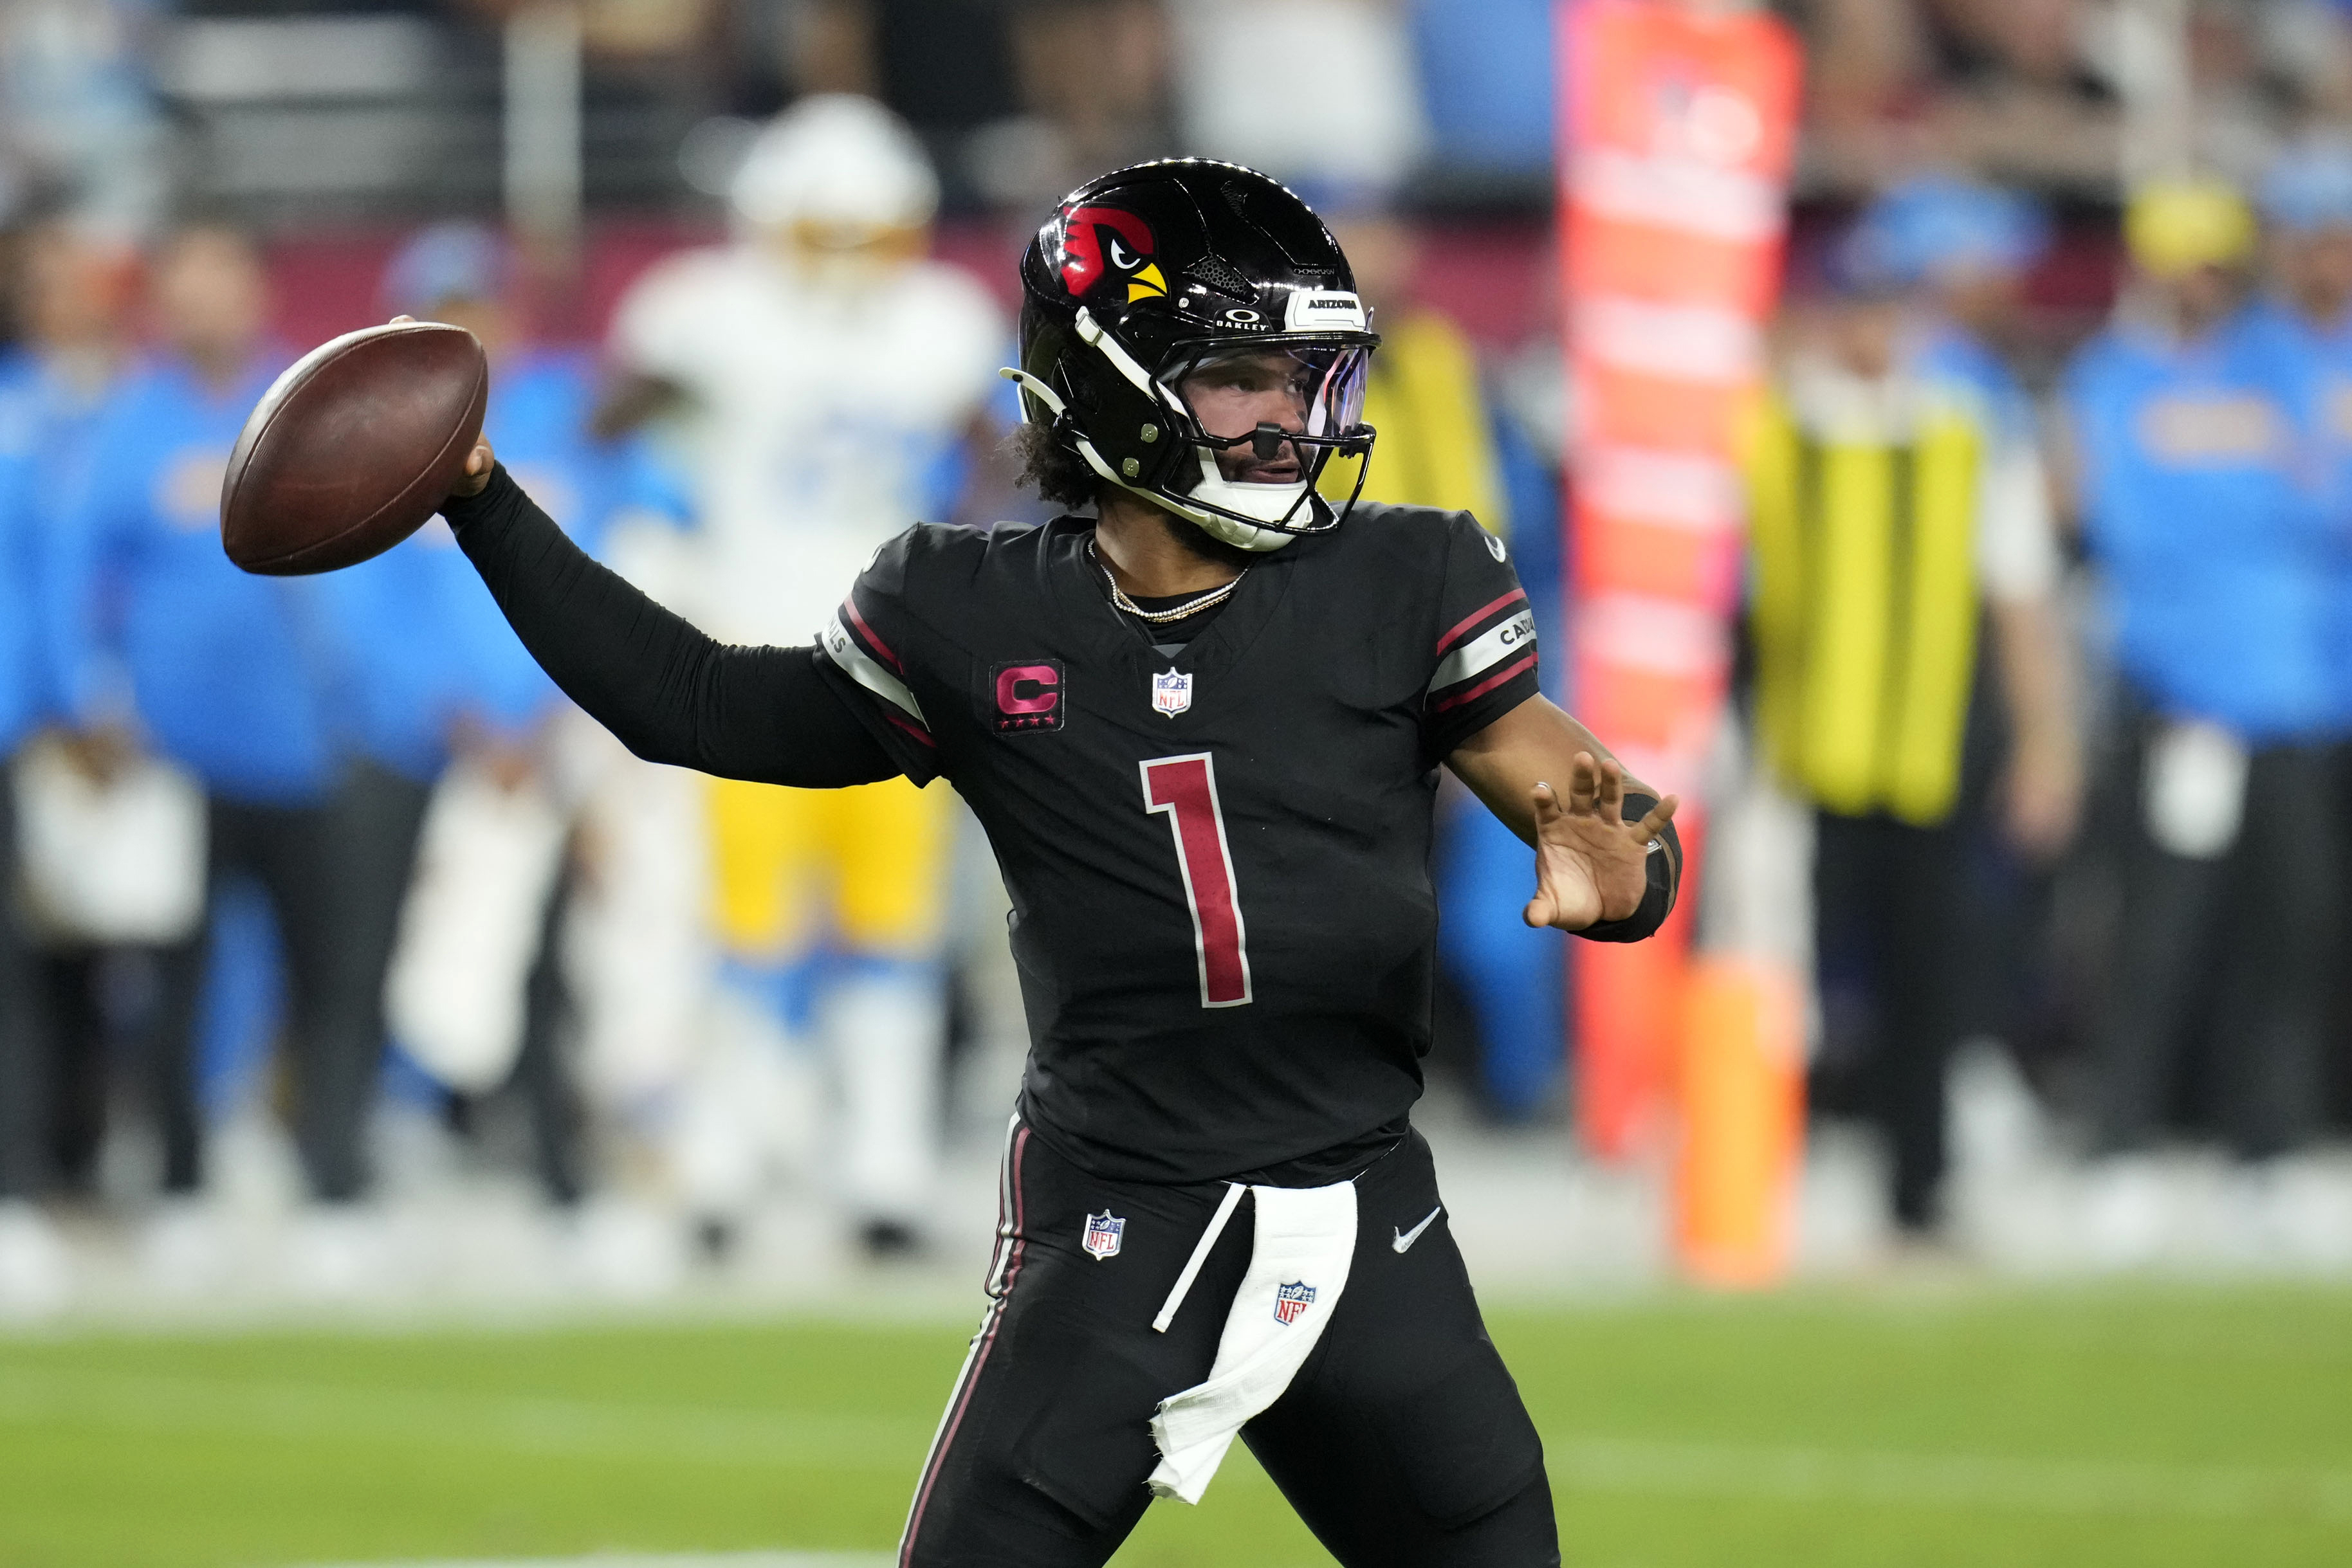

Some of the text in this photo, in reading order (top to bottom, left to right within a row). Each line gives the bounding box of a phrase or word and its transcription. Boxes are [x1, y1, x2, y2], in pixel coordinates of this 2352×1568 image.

[1308, 299, 1357, 310] ARIZONA
[1216, 320, 1267, 331] OAKLEY
[997, 665, 1058, 715] C
[1159, 690, 1184, 709] NFL
[1139, 751, 1253, 1008] 1
[1089, 1231, 1114, 1250] NFL
